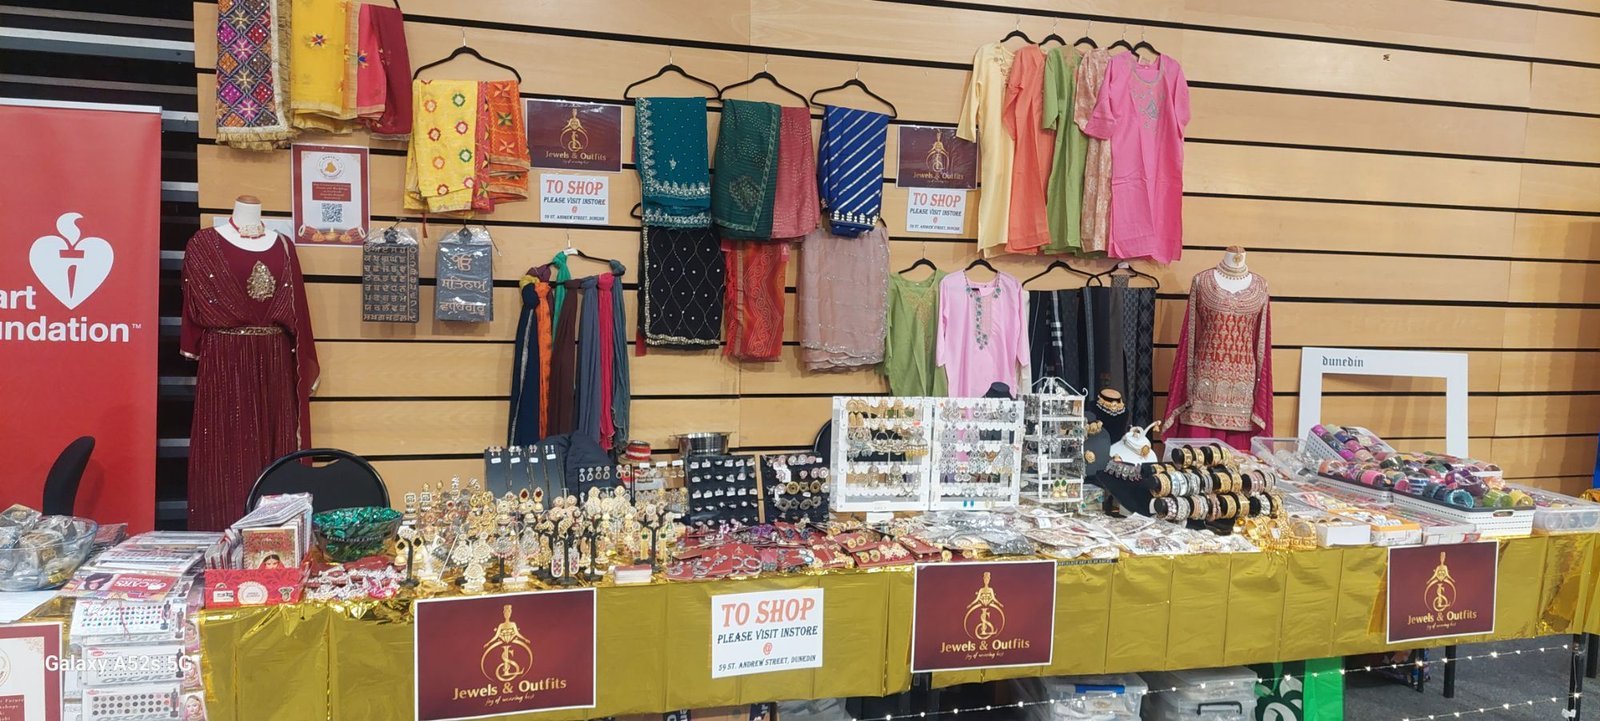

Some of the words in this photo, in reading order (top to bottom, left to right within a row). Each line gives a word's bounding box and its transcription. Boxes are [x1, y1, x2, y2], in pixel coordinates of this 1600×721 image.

[546, 151, 569, 159] Jewels
[580, 152, 606, 160] Outfits
[546, 180, 564, 194] TO
[567, 181, 603, 195] SHOP
[913, 192, 928, 206] TO
[930, 194, 961, 208] SHOP
[0, 316, 129, 342] ndation
[1322, 355, 1364, 367] dunedin
[722, 603, 750, 627] TO
[755, 598, 815, 624] SHOP
[1408, 613, 1435, 625] Jewels
[1436, 612, 1444, 621] &
[1446, 610, 1477, 621] Outfits
[718, 631, 753, 644] PLEASE
[756, 628, 779, 640] VISIT
[780, 625, 818, 638] INSTORE
[763, 642, 773, 655] @
[940, 641, 976, 653] Jewels
[979, 640, 988, 650] &
[992, 638, 1030, 650] Outfits
[718, 664, 726, 672] 59
[727, 662, 737, 670] ST.
[739, 658, 765, 668] ANDREW
[765, 657, 790, 665] STREET,
[791, 655, 816, 663] DUNEDIN
[452, 684, 498, 700] Jewels
[502, 682, 514, 694] &
[518, 677, 567, 693] Outfits
